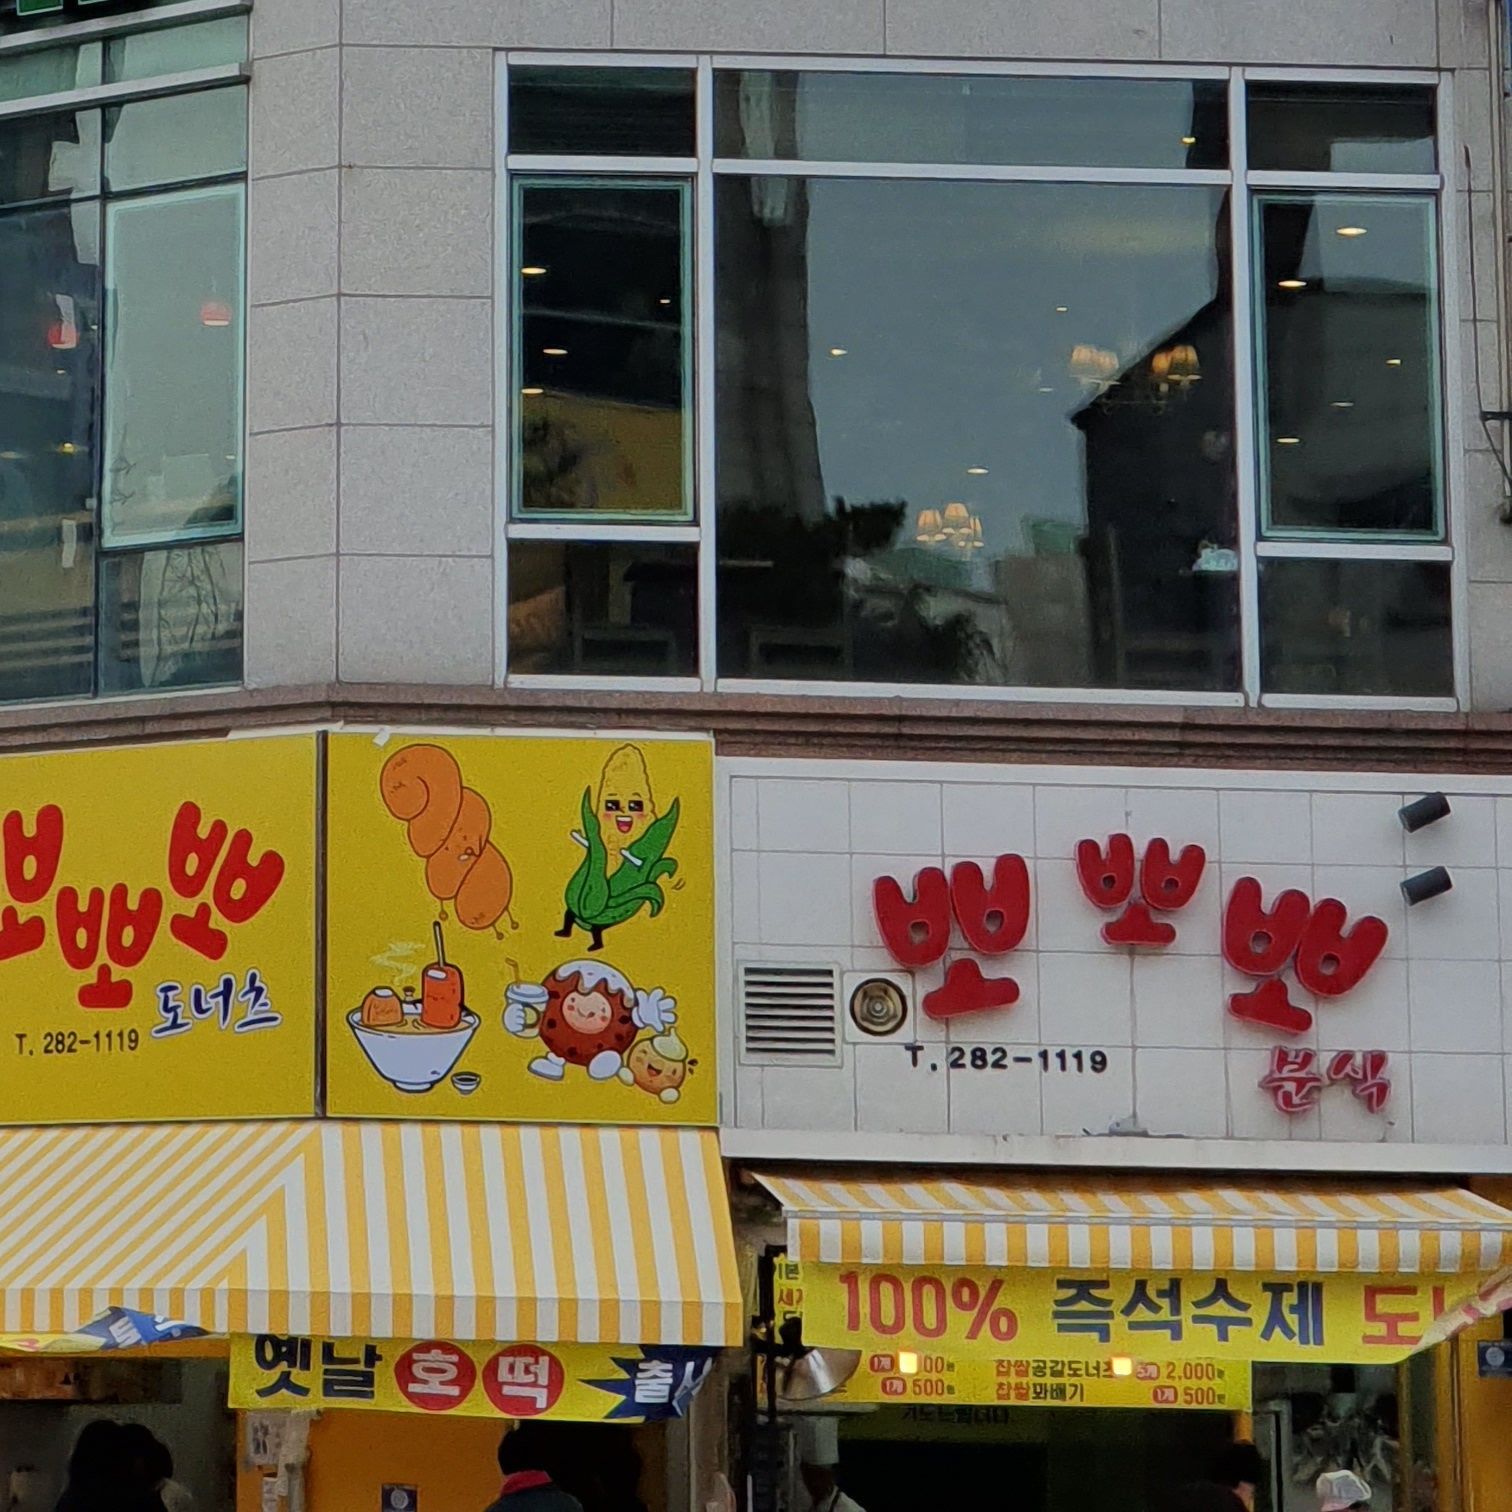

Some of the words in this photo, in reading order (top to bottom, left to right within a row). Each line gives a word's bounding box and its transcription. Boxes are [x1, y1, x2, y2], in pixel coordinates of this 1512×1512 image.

[150, 968, 284, 1040] 도너츠
[41, 1027, 141, 1056] 282-1119
[948, 1045, 1110, 1075] 282-1119
[1257, 1045, 1392, 1116] 분식
[838, 1270, 1019, 1342] 100%
[1051, 1276, 1325, 1347] 즉석수제
[253, 1332, 384, 1402] 옛날
